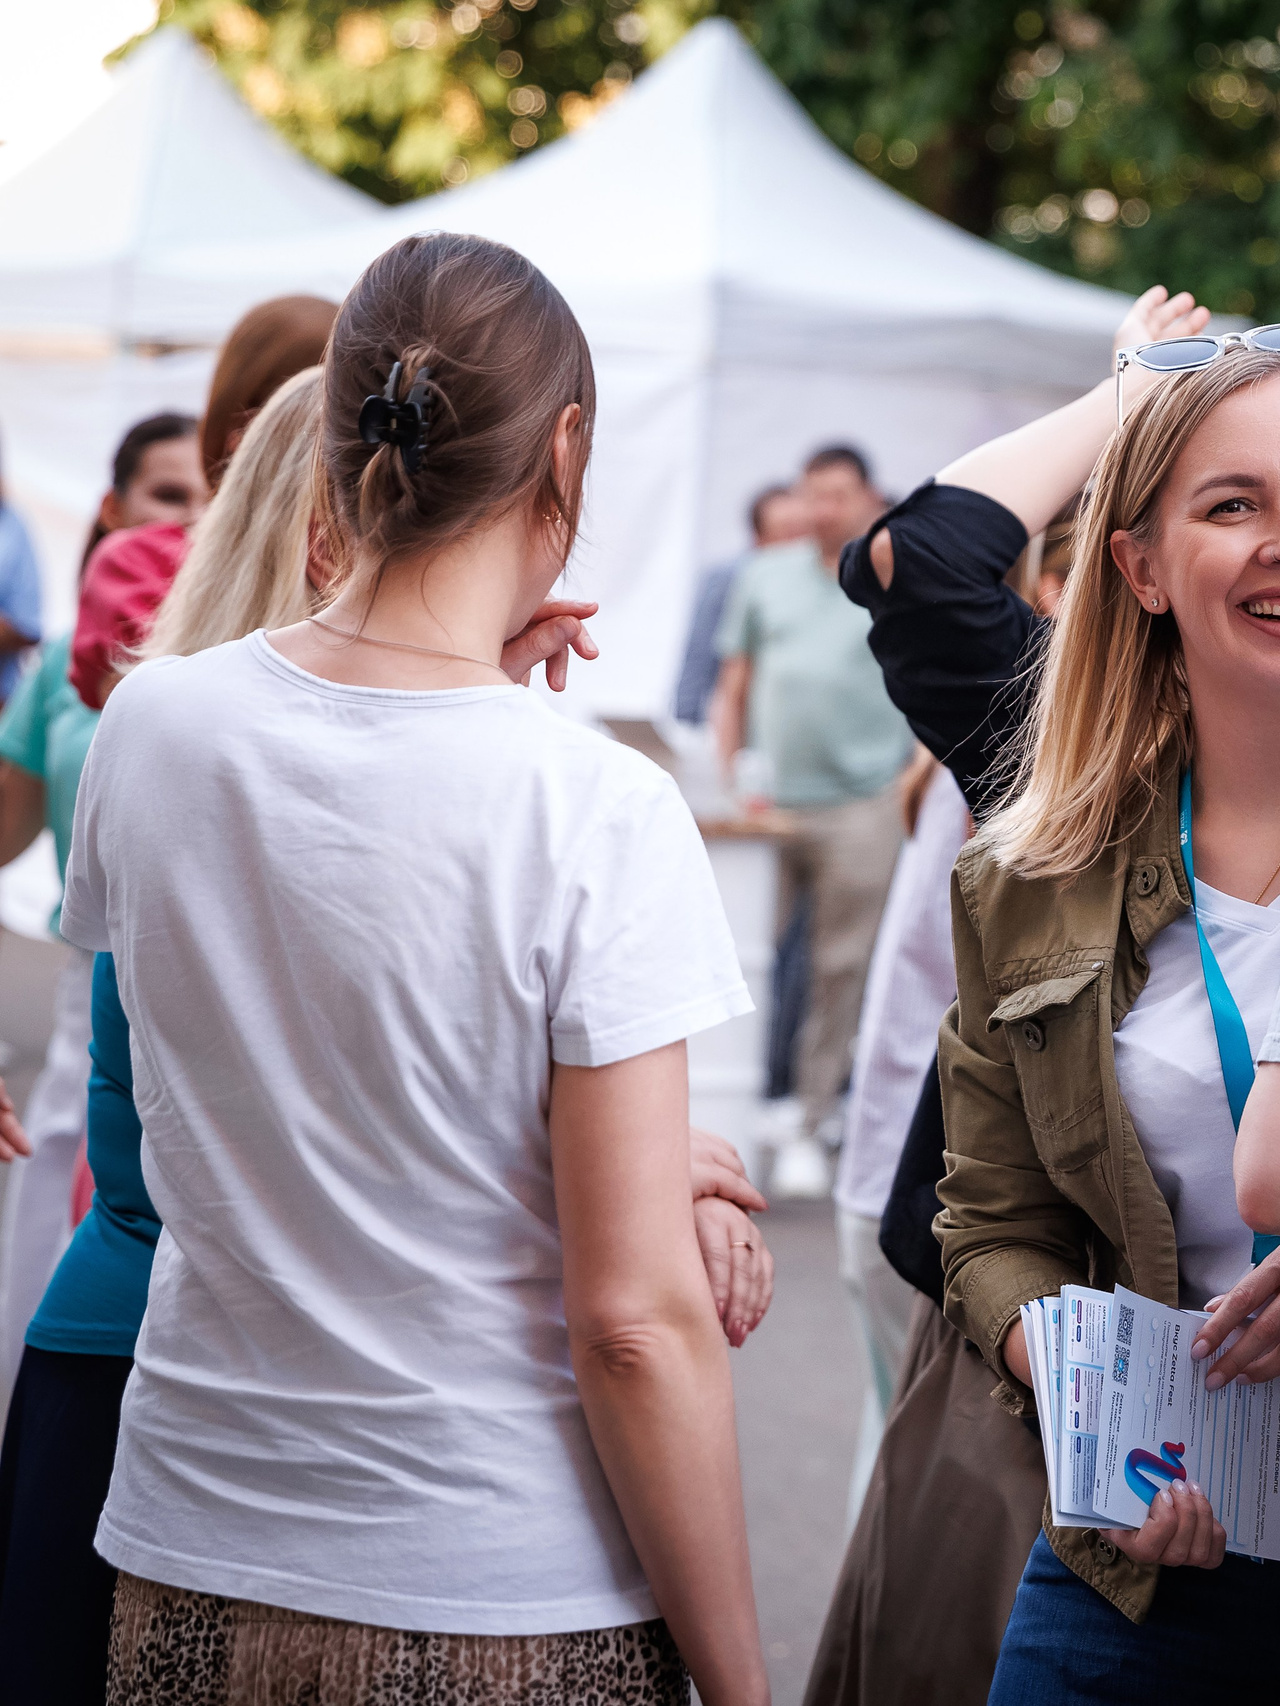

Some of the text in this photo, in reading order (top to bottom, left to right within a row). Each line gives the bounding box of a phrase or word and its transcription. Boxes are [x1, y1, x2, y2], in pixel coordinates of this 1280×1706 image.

[1167, 1324, 1181, 1407] Вкус Zetta Fest
